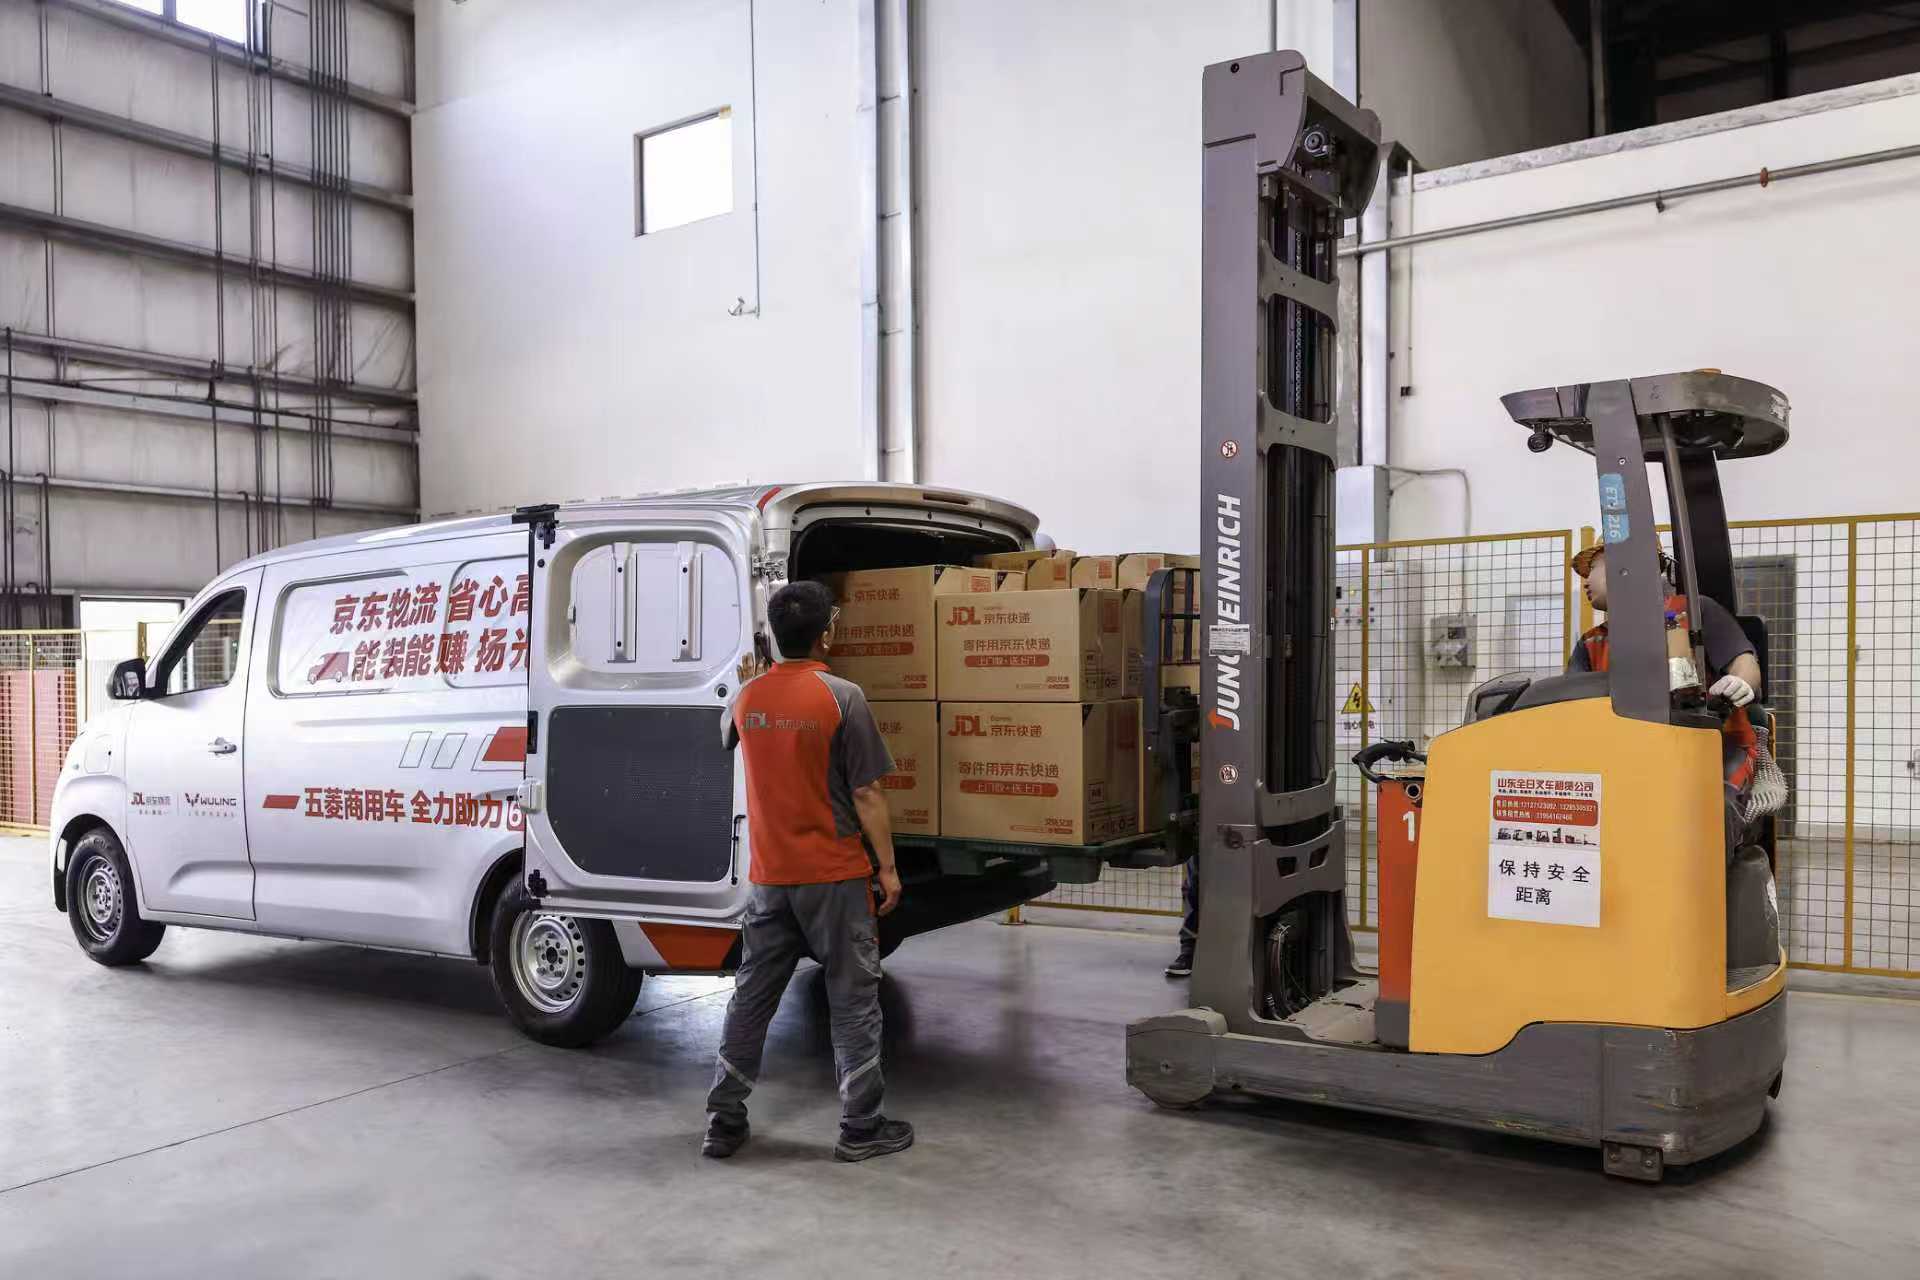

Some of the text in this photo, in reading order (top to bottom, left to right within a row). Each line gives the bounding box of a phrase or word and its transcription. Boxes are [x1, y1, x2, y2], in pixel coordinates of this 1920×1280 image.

[329, 582, 442, 635] 京东物流
[946, 606, 1032, 626] JDL 京东快递
[1217, 494, 1241, 731] JUNEINRICH
[351, 630, 469, 682] 能装能赚
[948, 715, 1042, 738] JDL 京东快递
[958, 761, 1059, 778] 寄件用京东快递
[200, 797, 238, 807] WULING
[304, 787, 406, 823] 五菱商用车
[1402, 810, 1416, 842] 1
[1499, 859, 1591, 883] 保持安全
[1516, 886, 1552, 906] 距离
